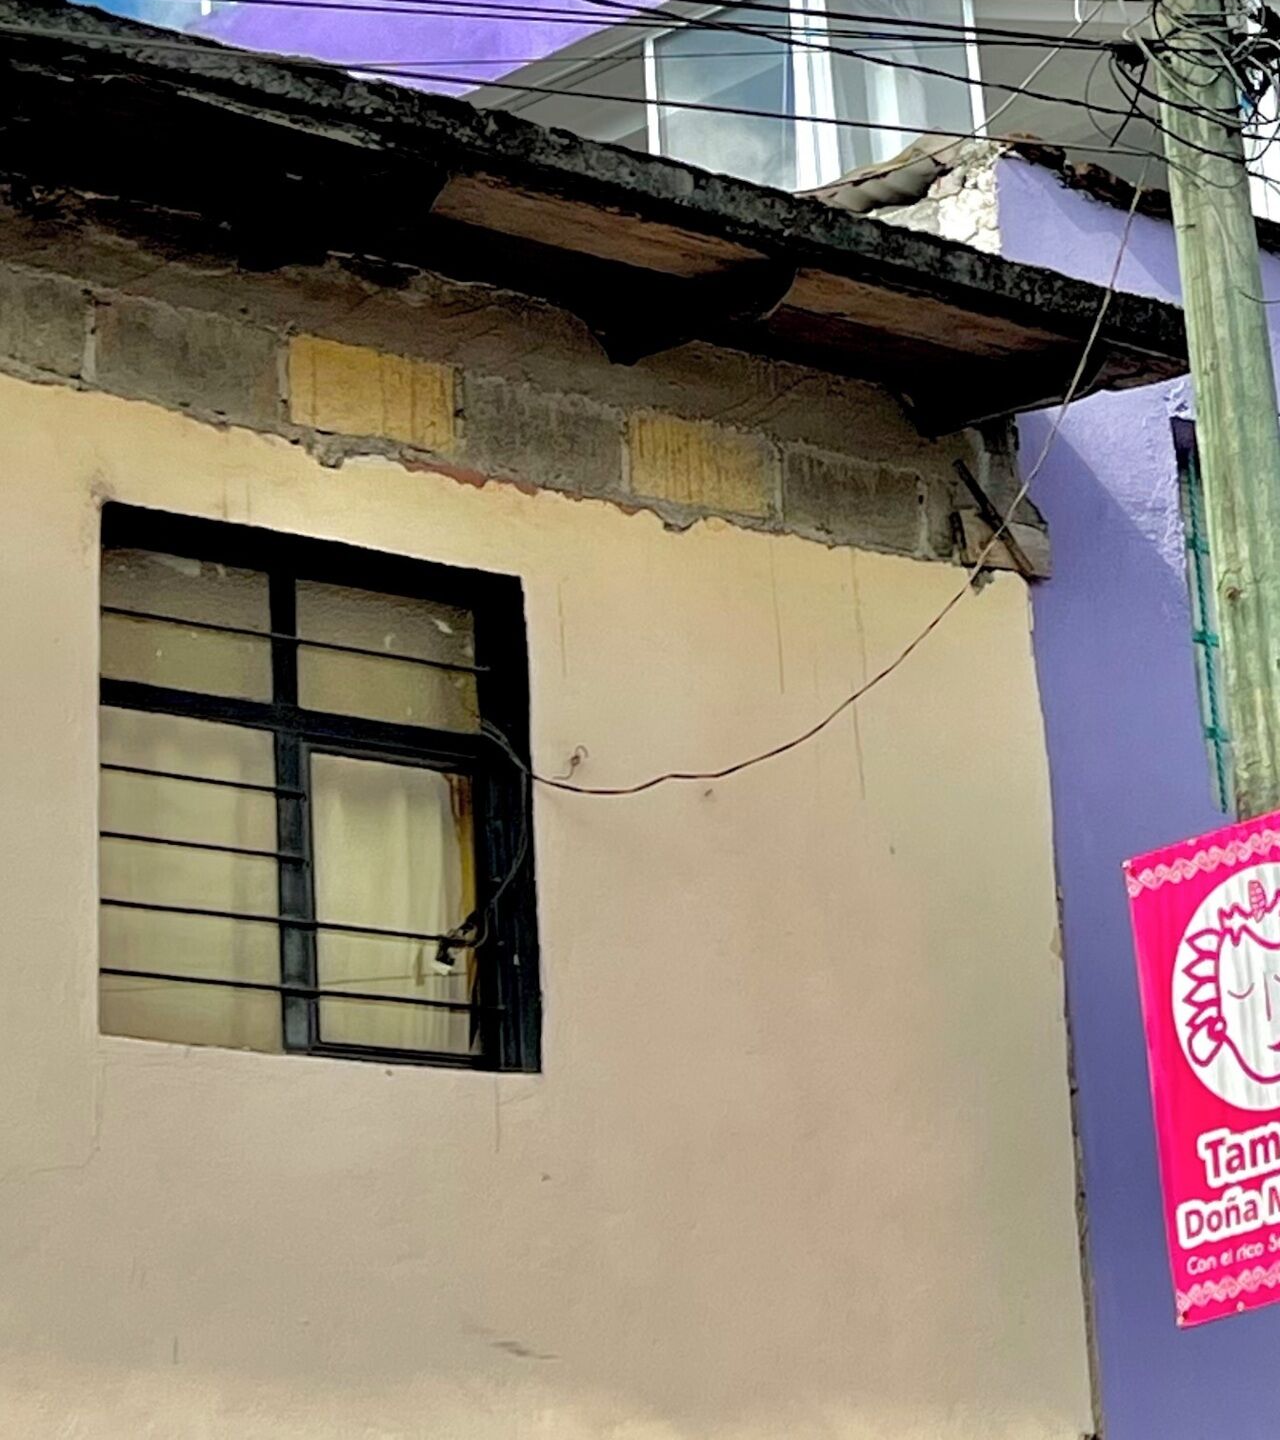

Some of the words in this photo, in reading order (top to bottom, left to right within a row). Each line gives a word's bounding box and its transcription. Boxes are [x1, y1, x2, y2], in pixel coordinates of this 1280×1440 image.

[1184, 1195, 1259, 1240] Doña
[1186, 1255, 1218, 1275] Con
[1220, 1248, 1233, 1266] el
[1235, 1242, 1264, 1262] rico
